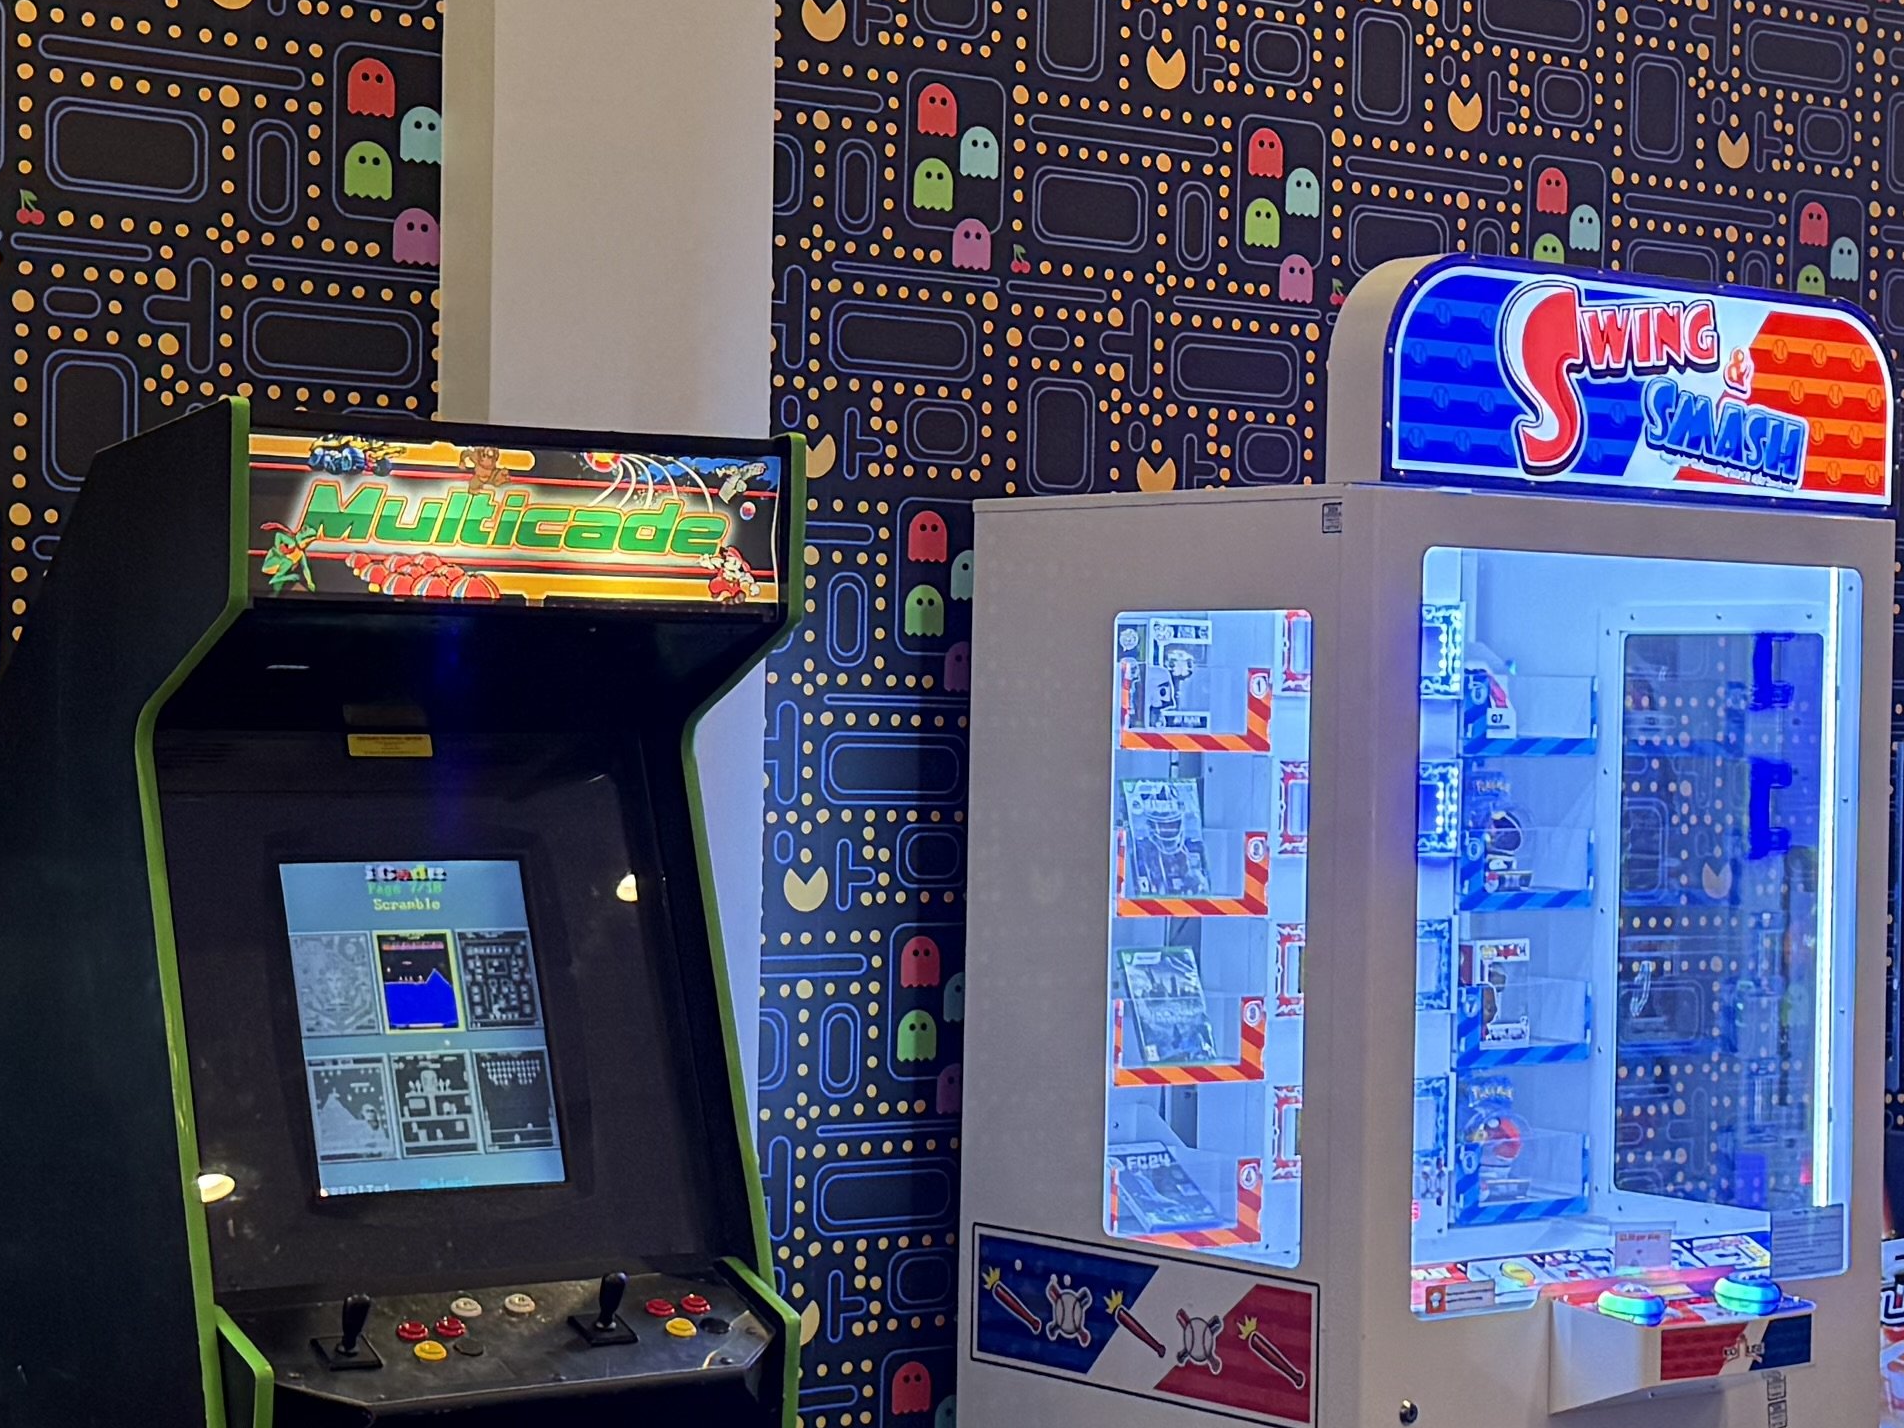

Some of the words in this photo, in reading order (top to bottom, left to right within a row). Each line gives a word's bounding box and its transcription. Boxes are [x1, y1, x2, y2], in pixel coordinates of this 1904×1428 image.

[1501, 277, 1720, 477] SWING
[1725, 346, 1754, 396] &
[1644, 378, 1808, 486] SMASH
[302, 479, 730, 557] Multicade
